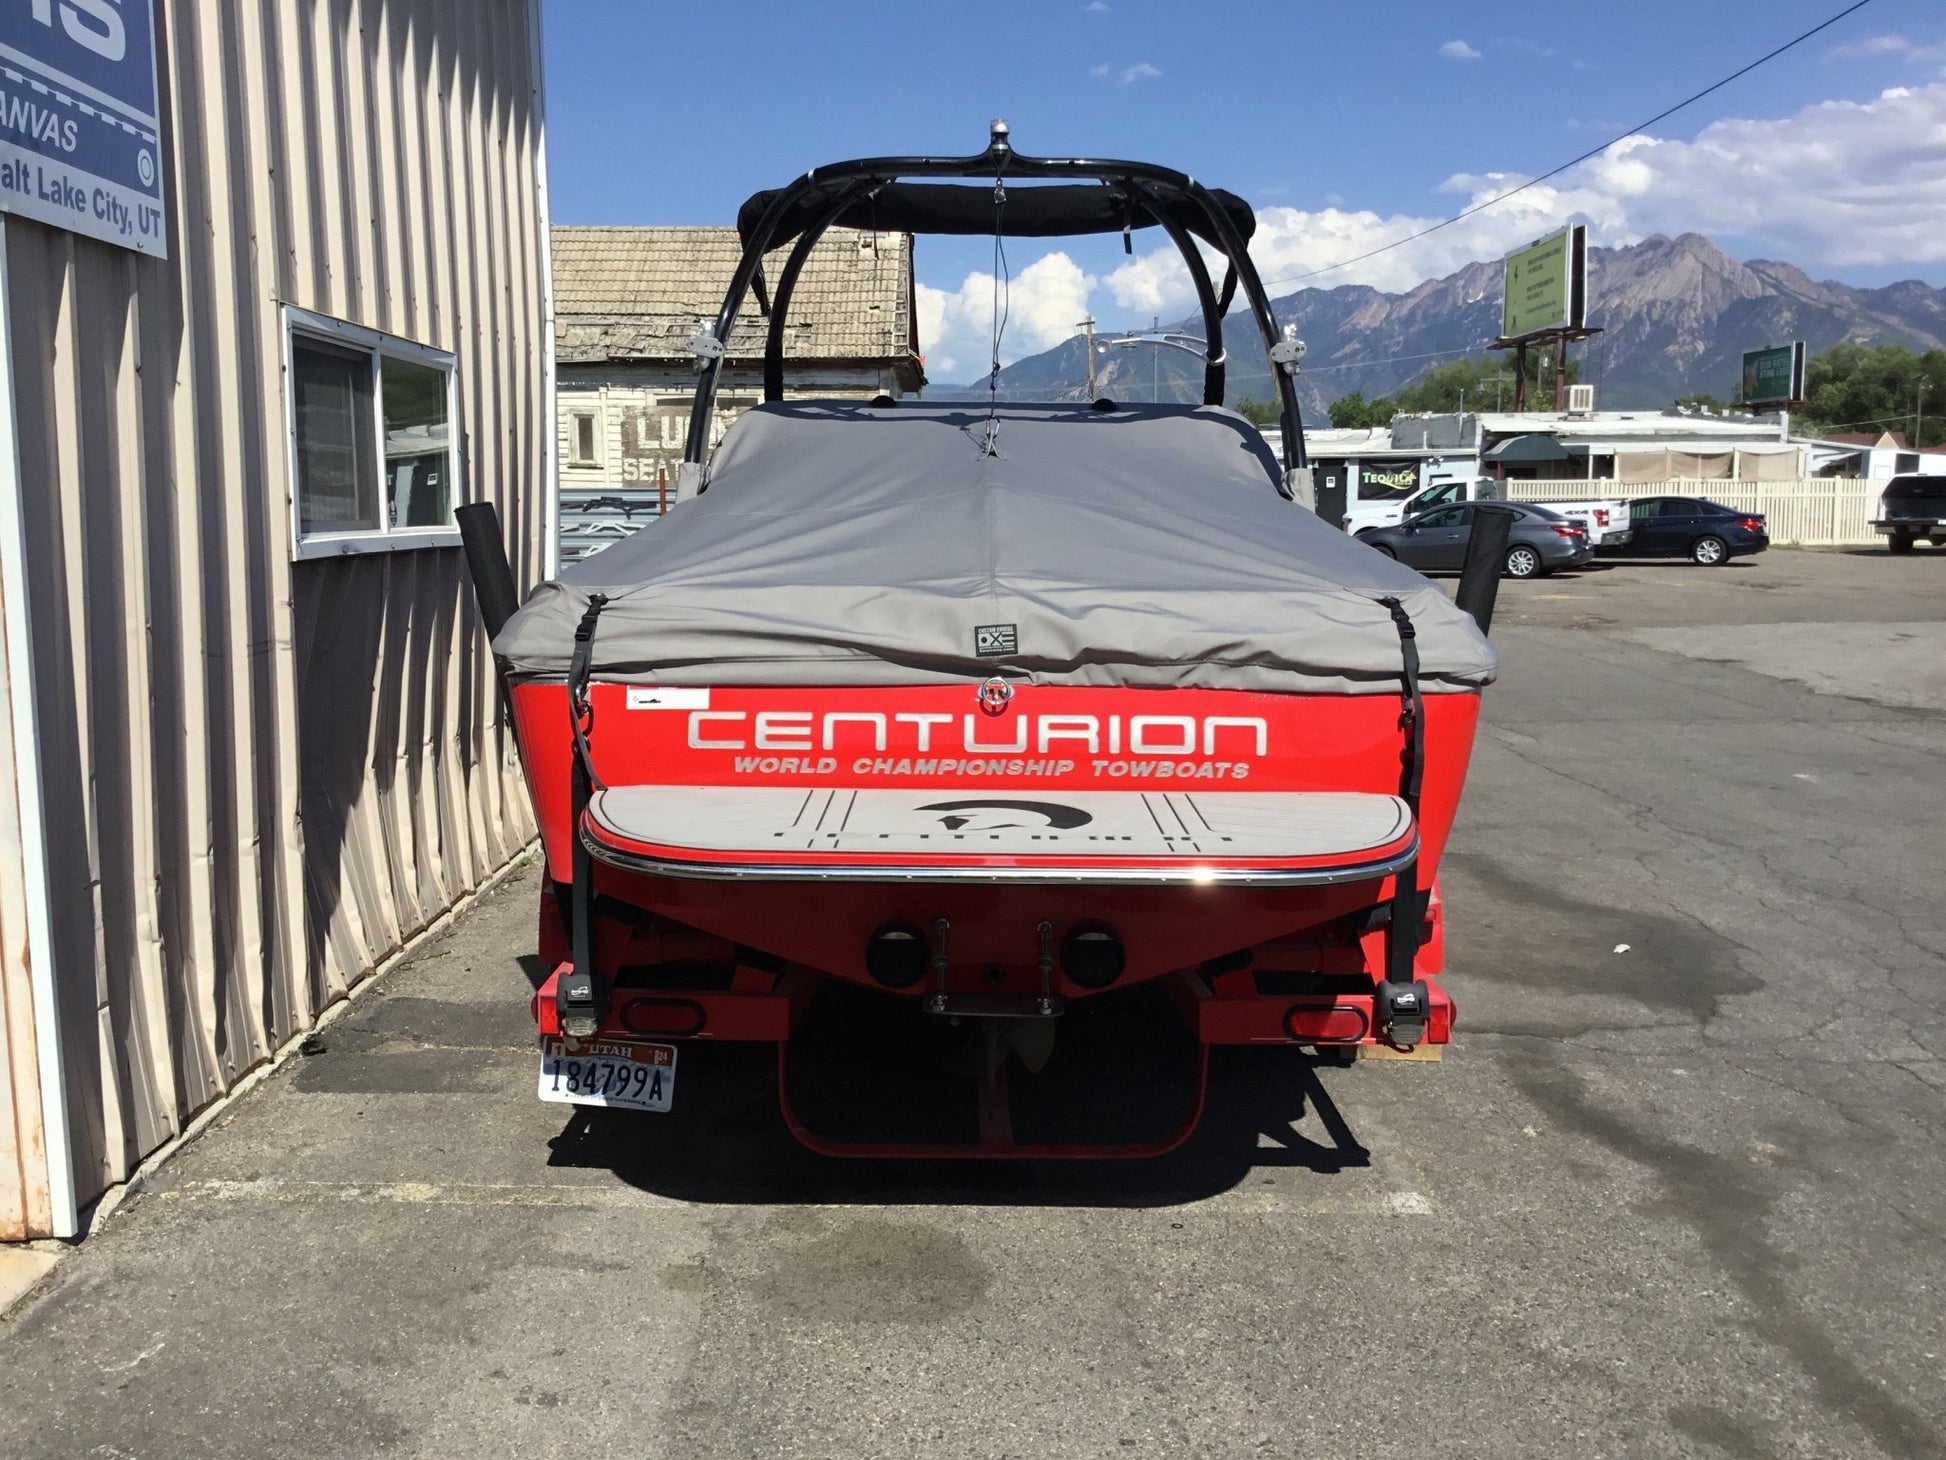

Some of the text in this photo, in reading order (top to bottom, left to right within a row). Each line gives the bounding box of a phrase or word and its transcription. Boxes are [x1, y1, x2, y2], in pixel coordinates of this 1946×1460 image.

[38, 166, 87, 213] Lake
[92, 188, 133, 236] City,
[138, 203, 161, 238] UT
[1362, 471, 1416, 489] TEQUILA
[687, 710, 1268, 757] CENTURION
[734, 756, 1250, 780] WORLD CHAMPIONSHIP TOWBOATS
[589, 1044, 632, 1058] UTAH
[551, 1060, 662, 1101] 184799A
